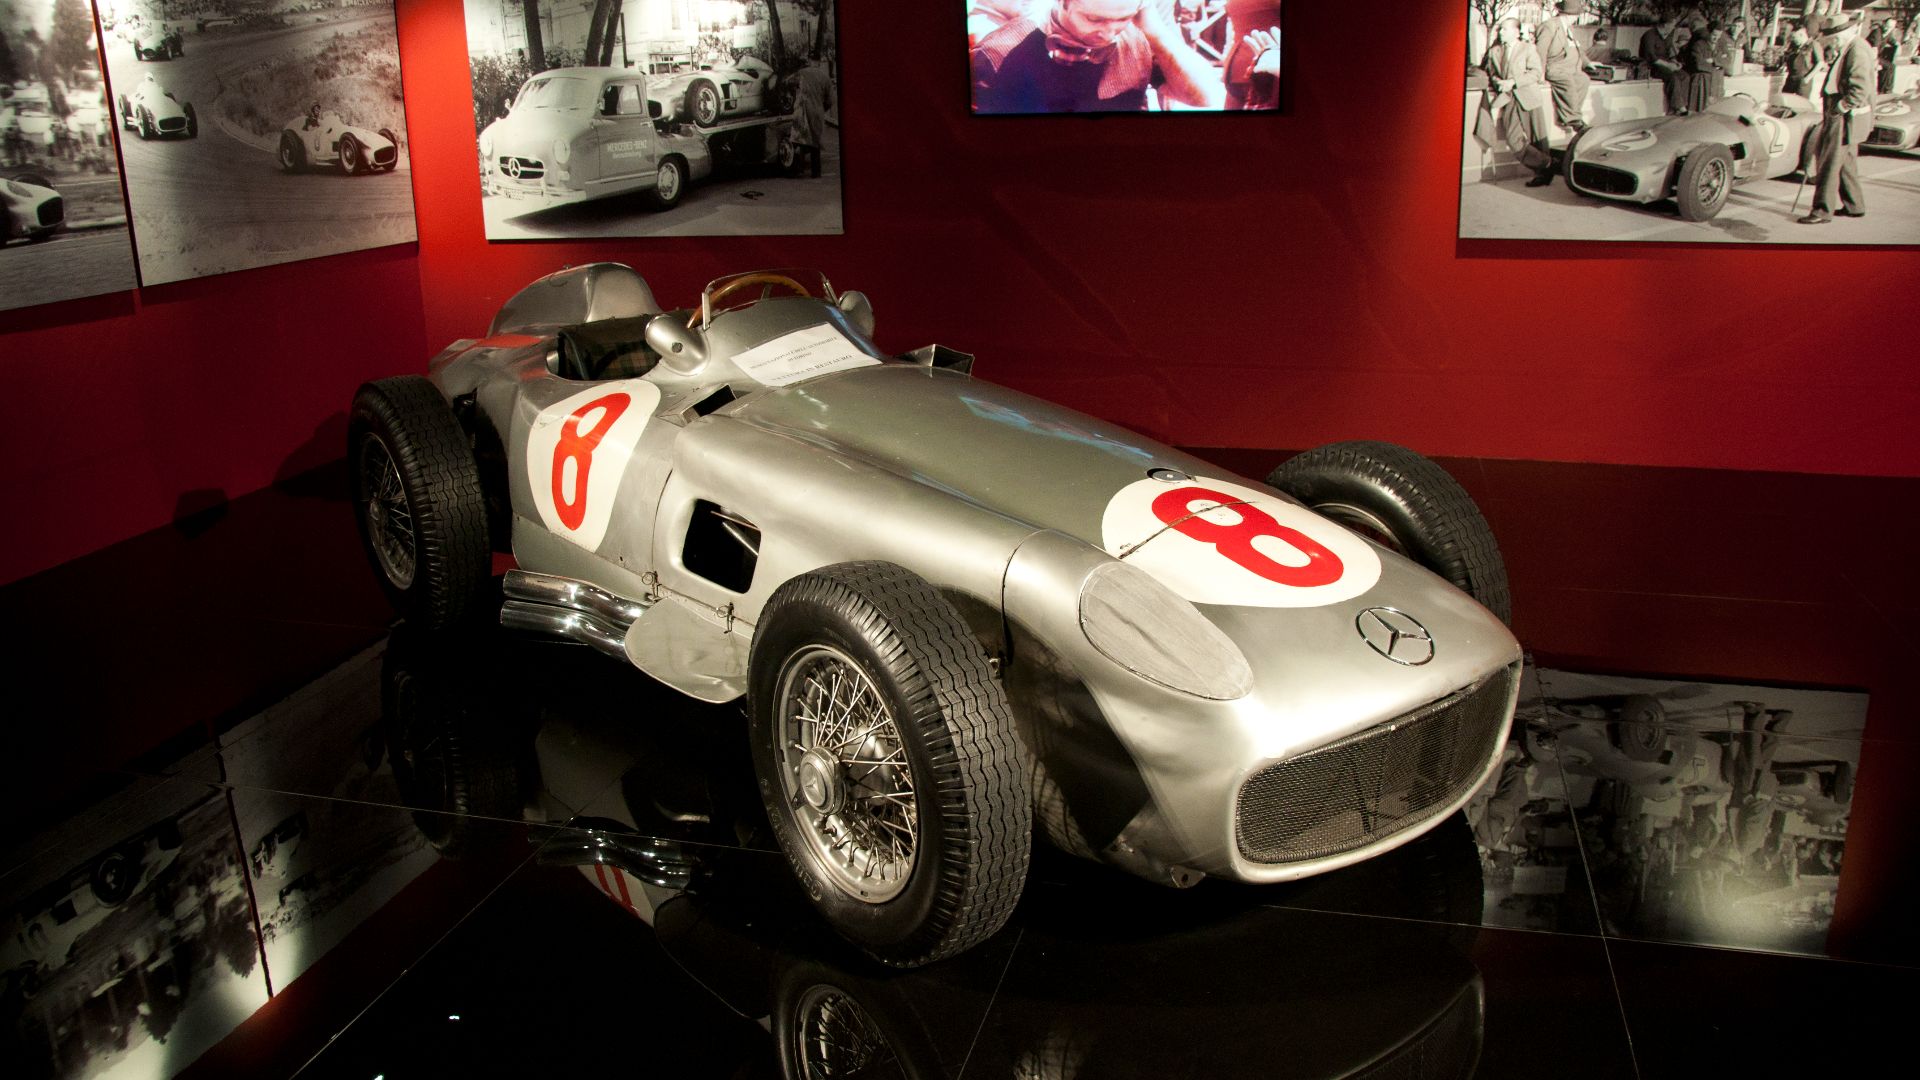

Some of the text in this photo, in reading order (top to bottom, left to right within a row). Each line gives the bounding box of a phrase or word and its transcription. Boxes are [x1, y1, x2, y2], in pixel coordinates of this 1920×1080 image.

[1606, 130, 1651, 150] 2
[1757, 117, 1784, 154] 2
[551, 392, 631, 531] 8
[1151, 486, 1345, 588] 8
